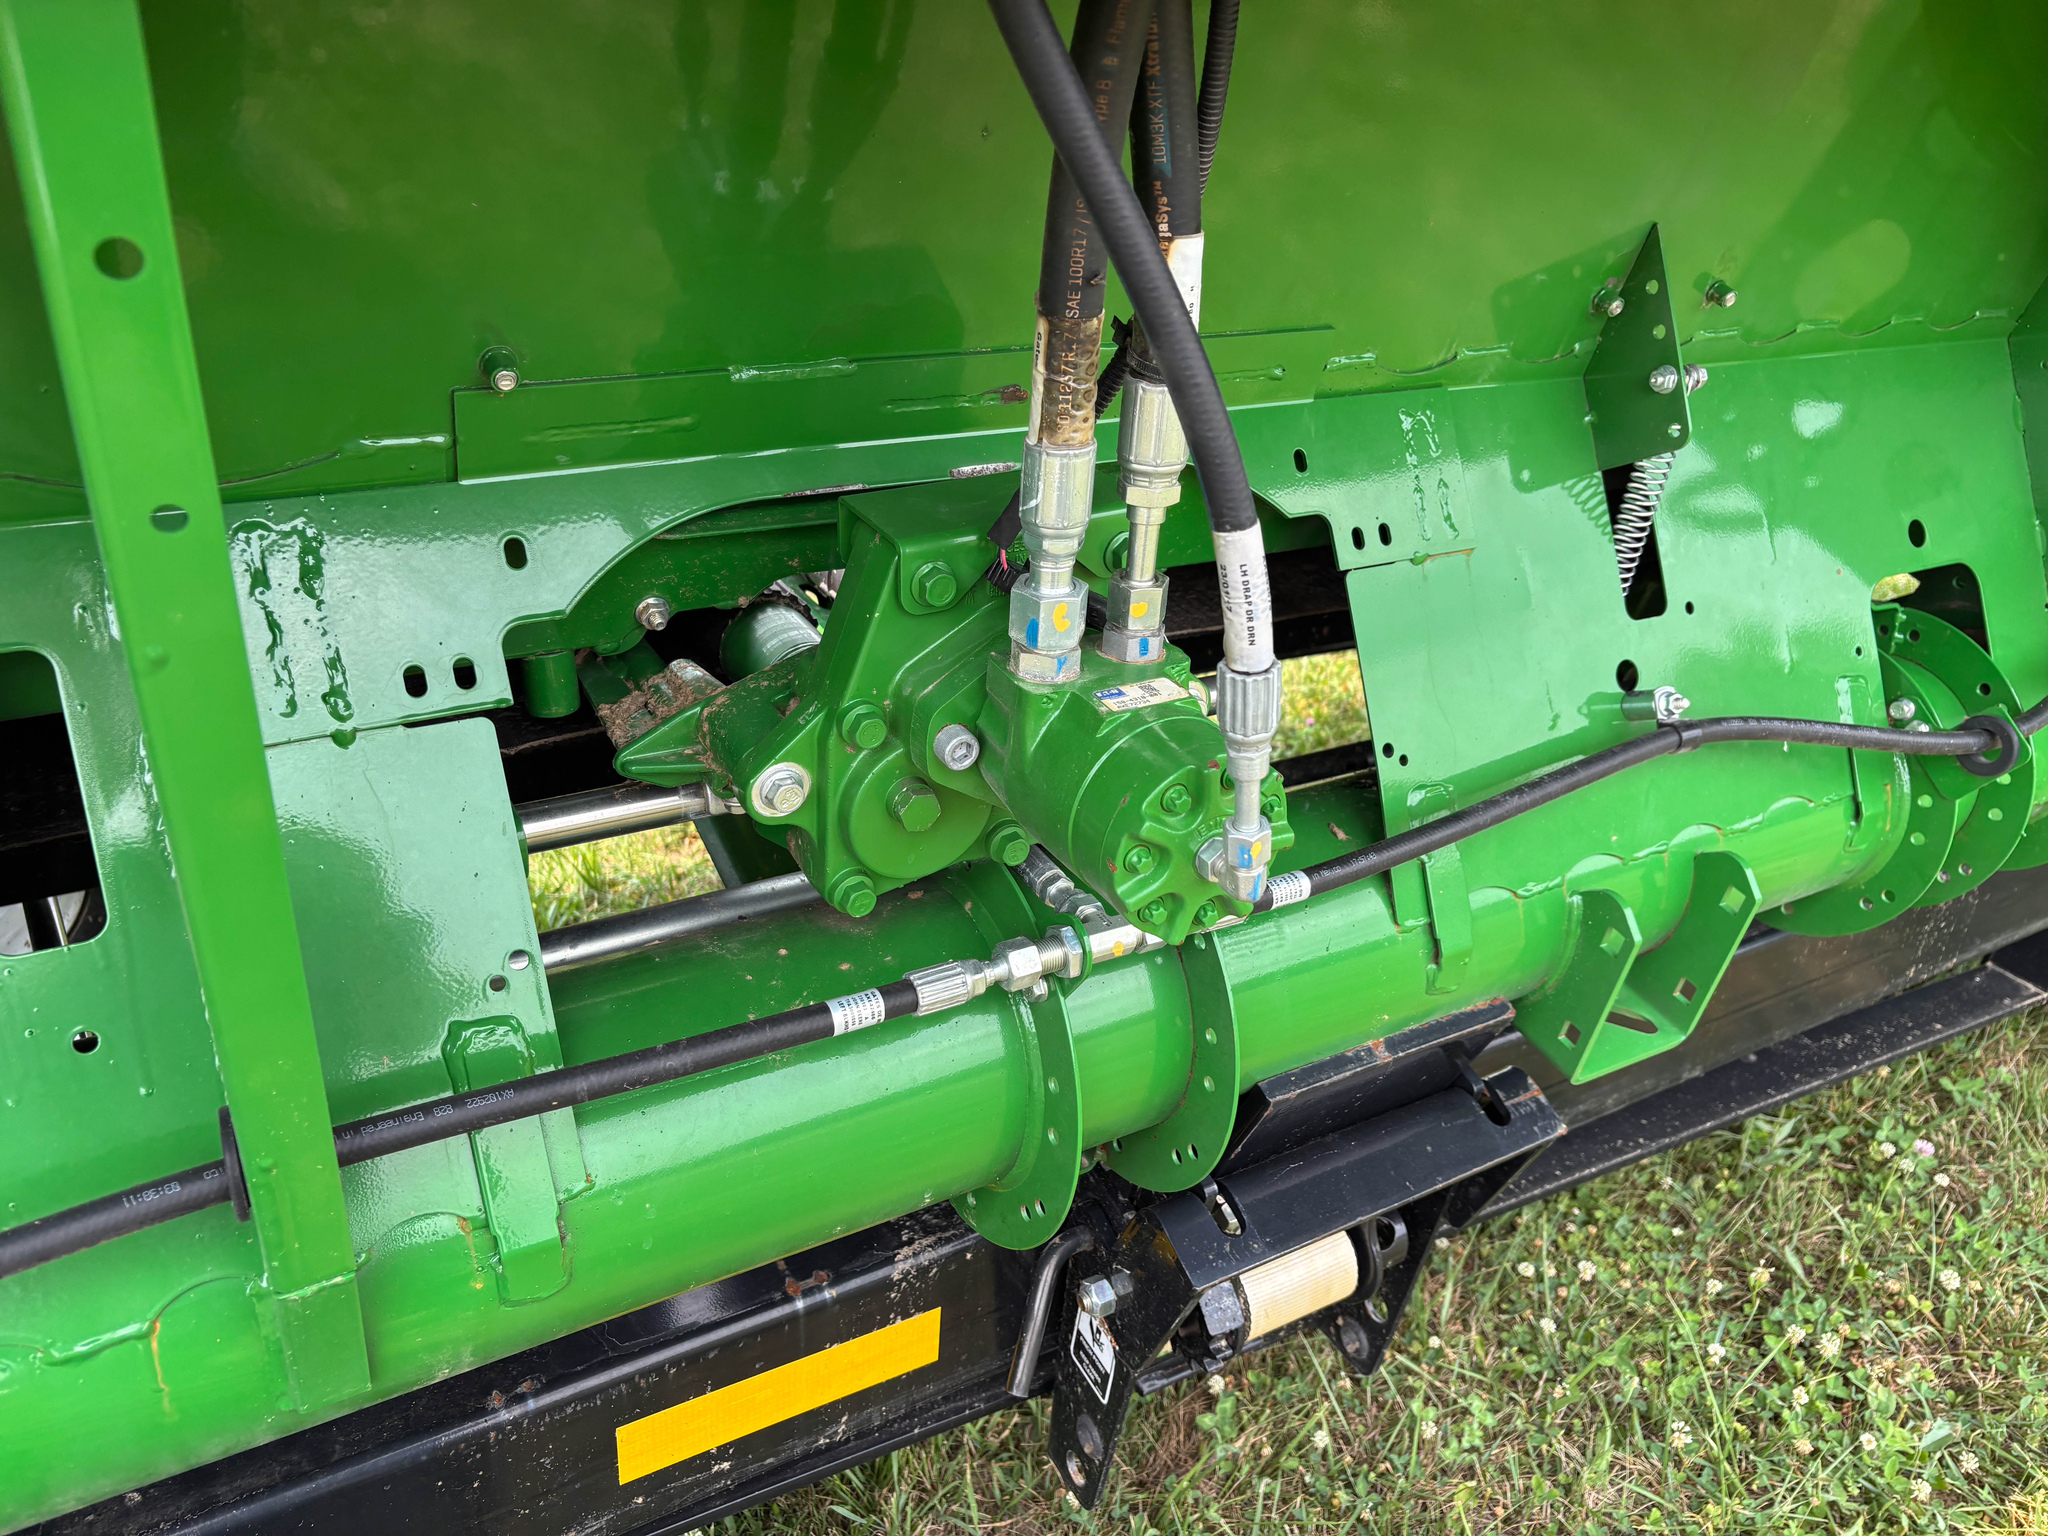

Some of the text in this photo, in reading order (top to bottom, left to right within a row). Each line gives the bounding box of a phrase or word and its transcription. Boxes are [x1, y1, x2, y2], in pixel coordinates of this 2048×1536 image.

[1096, 79, 1113, 91] B
[1148, 81, 1167, 163] 10M3K-XTF
[1069, 228, 1087, 285] 100R17
[1065, 289, 1081, 318] SAE
[1239, 563, 1257, 646] LH DRAP DR DRN
[464, 1087, 515, 1109] AX102922
[360, 1111, 424, 1136] Engineered
[121, 1180, 182, 1208] 03:38:11
